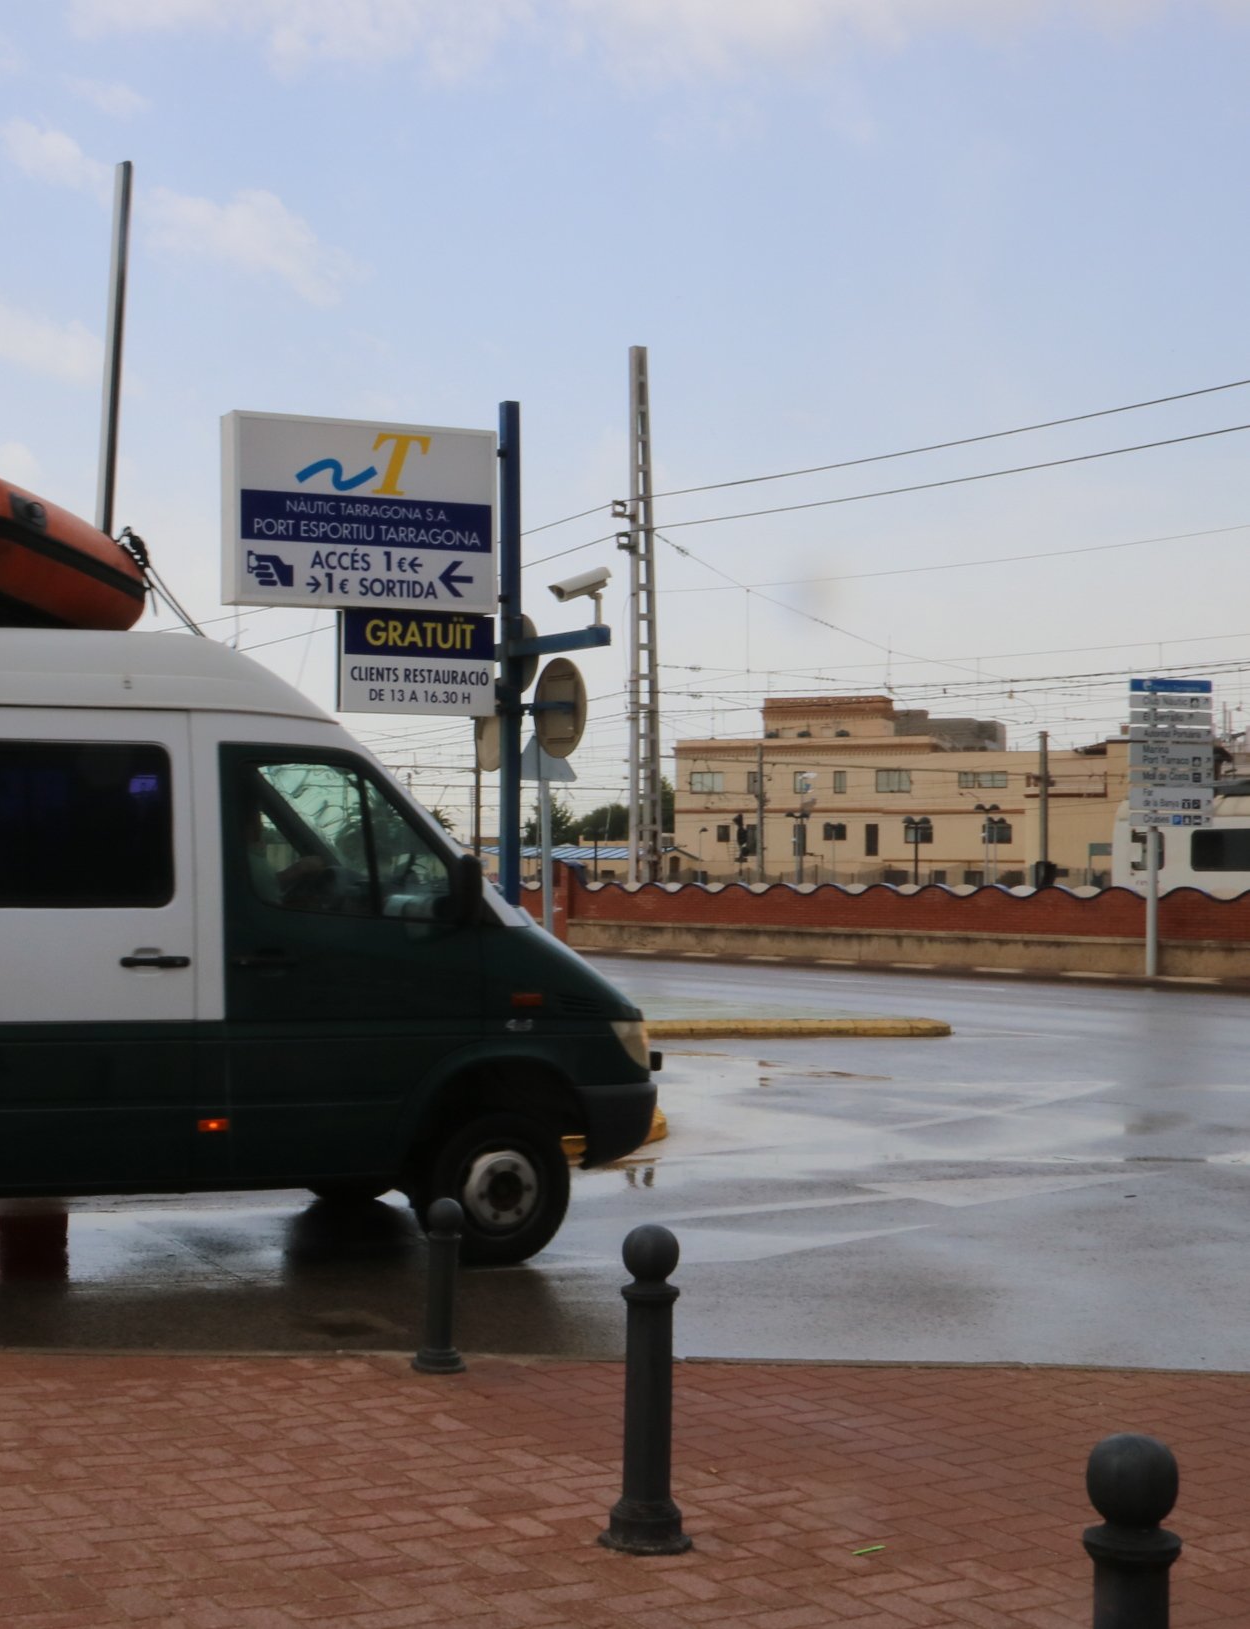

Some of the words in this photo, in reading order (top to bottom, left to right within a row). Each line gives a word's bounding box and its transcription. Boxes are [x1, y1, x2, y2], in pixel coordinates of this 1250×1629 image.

[286, 497, 336, 515] NÀUTIC
[340, 503, 422, 520] TARRAGONA
[253, 518, 295, 536] PORT
[300, 521, 375, 541] ESPORTIU
[379, 525, 481, 546] TARRAGONA
[310, 547, 371, 572] ACCÉS
[358, 577, 438, 600] SORTIDA
[365, 616, 476, 650] GRATUÏT
[350, 665, 399, 683] CLIENTS
[403, 668, 490, 687] RESTAURACIÓ
[368, 688, 385, 702] DE
[390, 689, 406, 703] 13
[408, 690, 419, 703] A
[423, 690, 459, 705] 16.30
[461, 692, 472, 705] H
